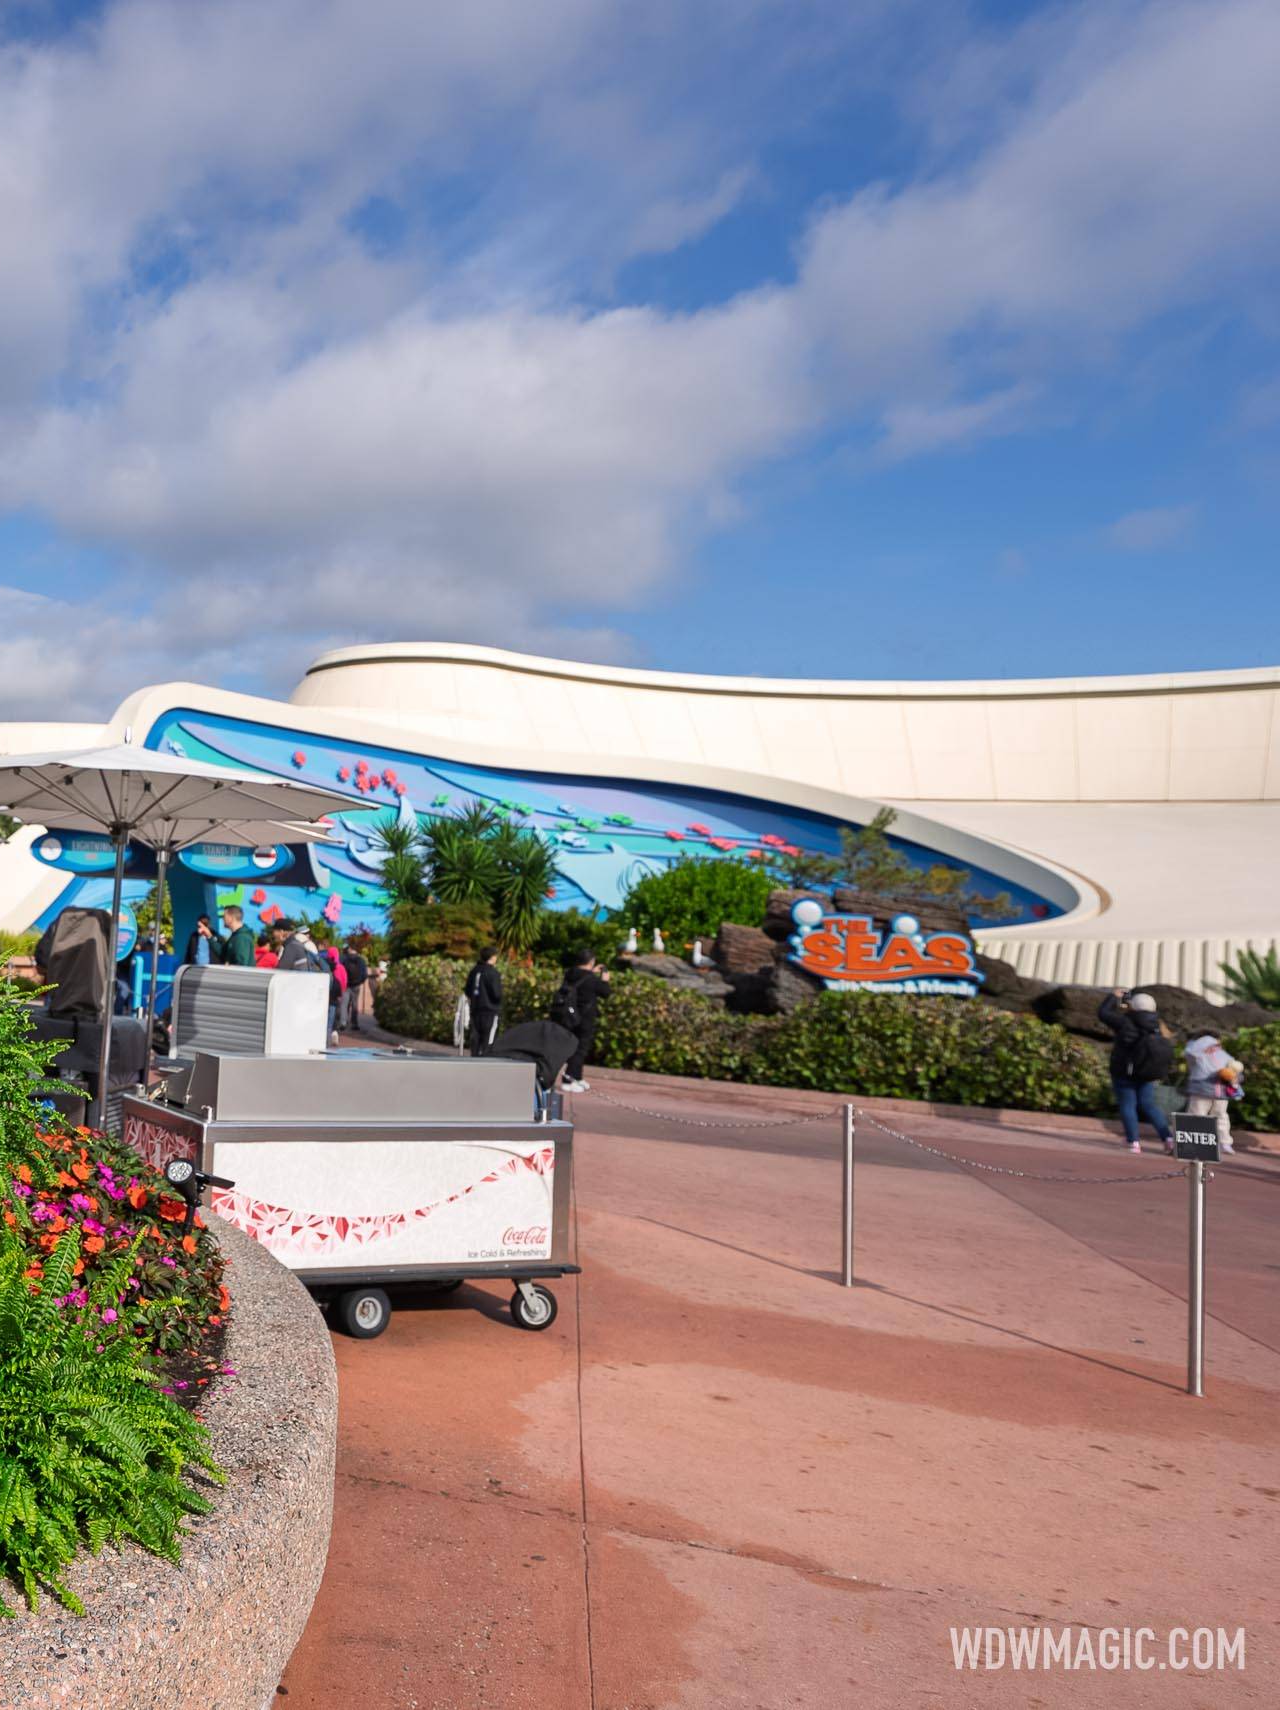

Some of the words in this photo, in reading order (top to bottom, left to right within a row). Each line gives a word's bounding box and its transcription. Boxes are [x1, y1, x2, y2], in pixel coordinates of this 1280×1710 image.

[823, 918, 869, 932] THE
[802, 931, 972, 971] SEAS
[1176, 1130, 1218, 1146] ENTER
